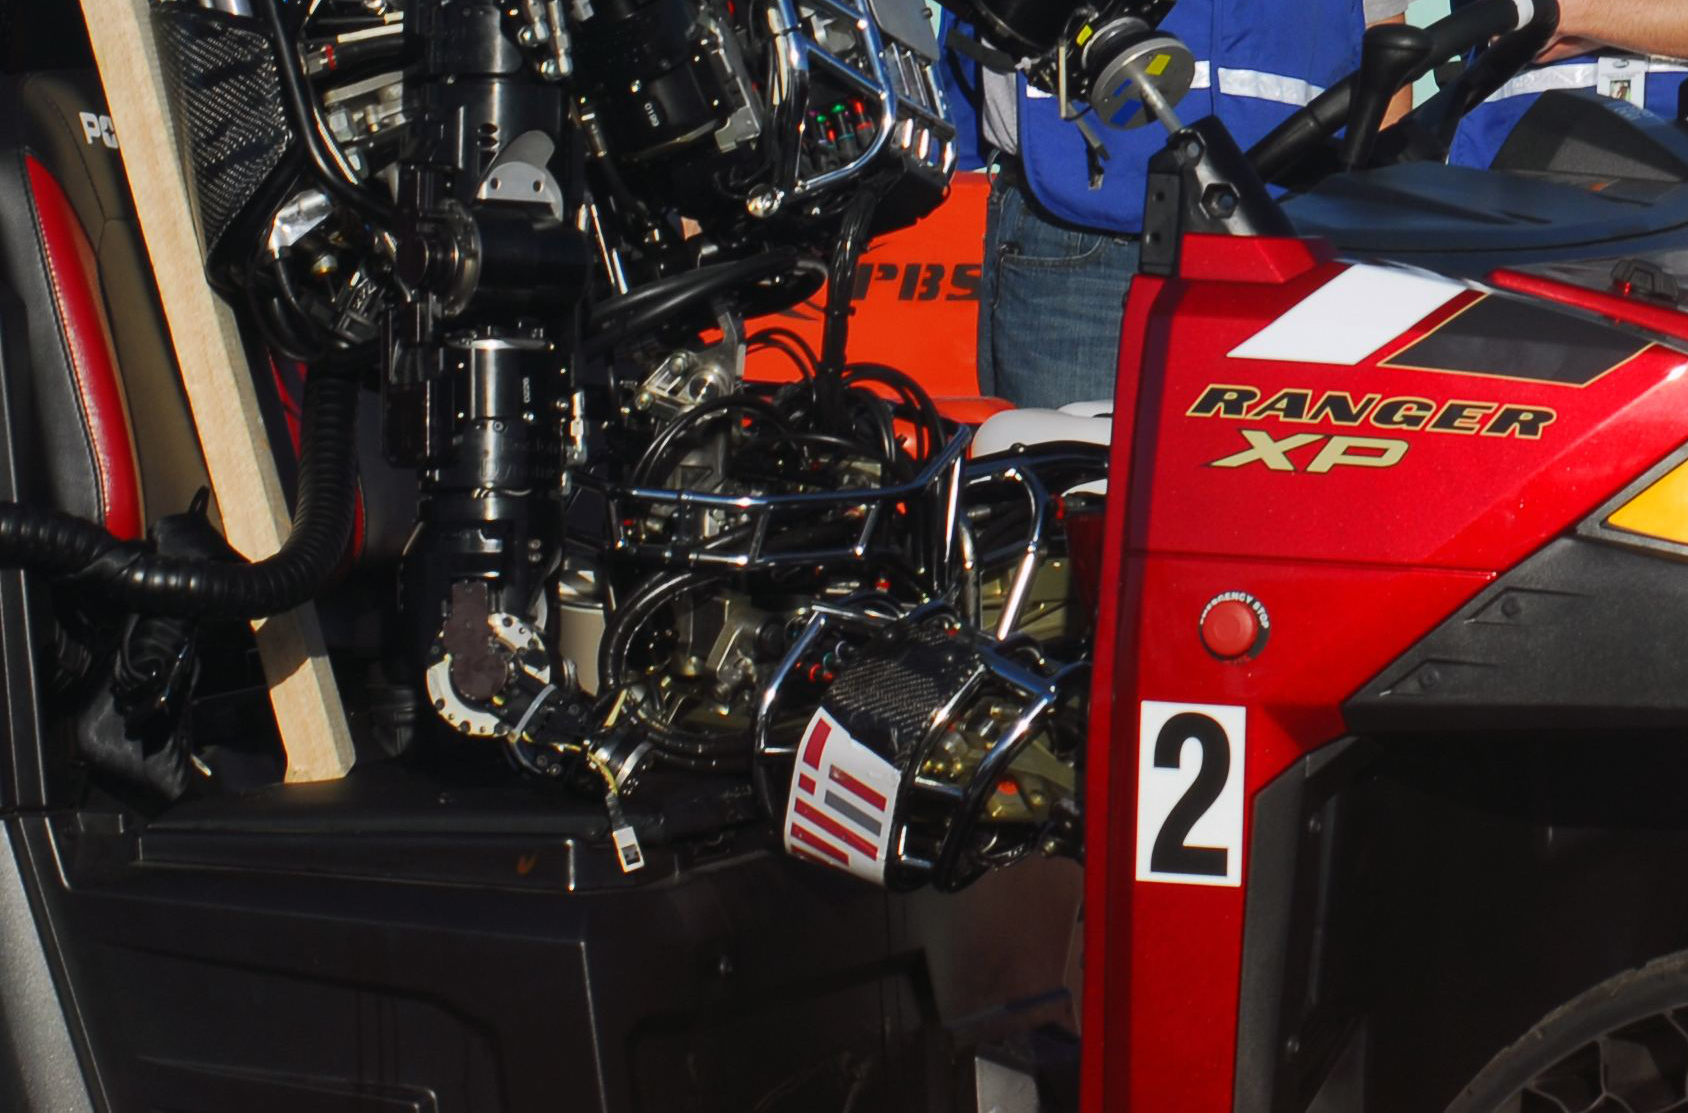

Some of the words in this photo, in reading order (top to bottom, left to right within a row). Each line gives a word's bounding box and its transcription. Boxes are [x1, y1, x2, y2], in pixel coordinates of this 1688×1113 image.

[850, 263, 983, 301] PBS
[1185, 383, 1558, 440] RANGER
[1203, 428, 1411, 475] XP
[1150, 712, 1231, 877] 2
